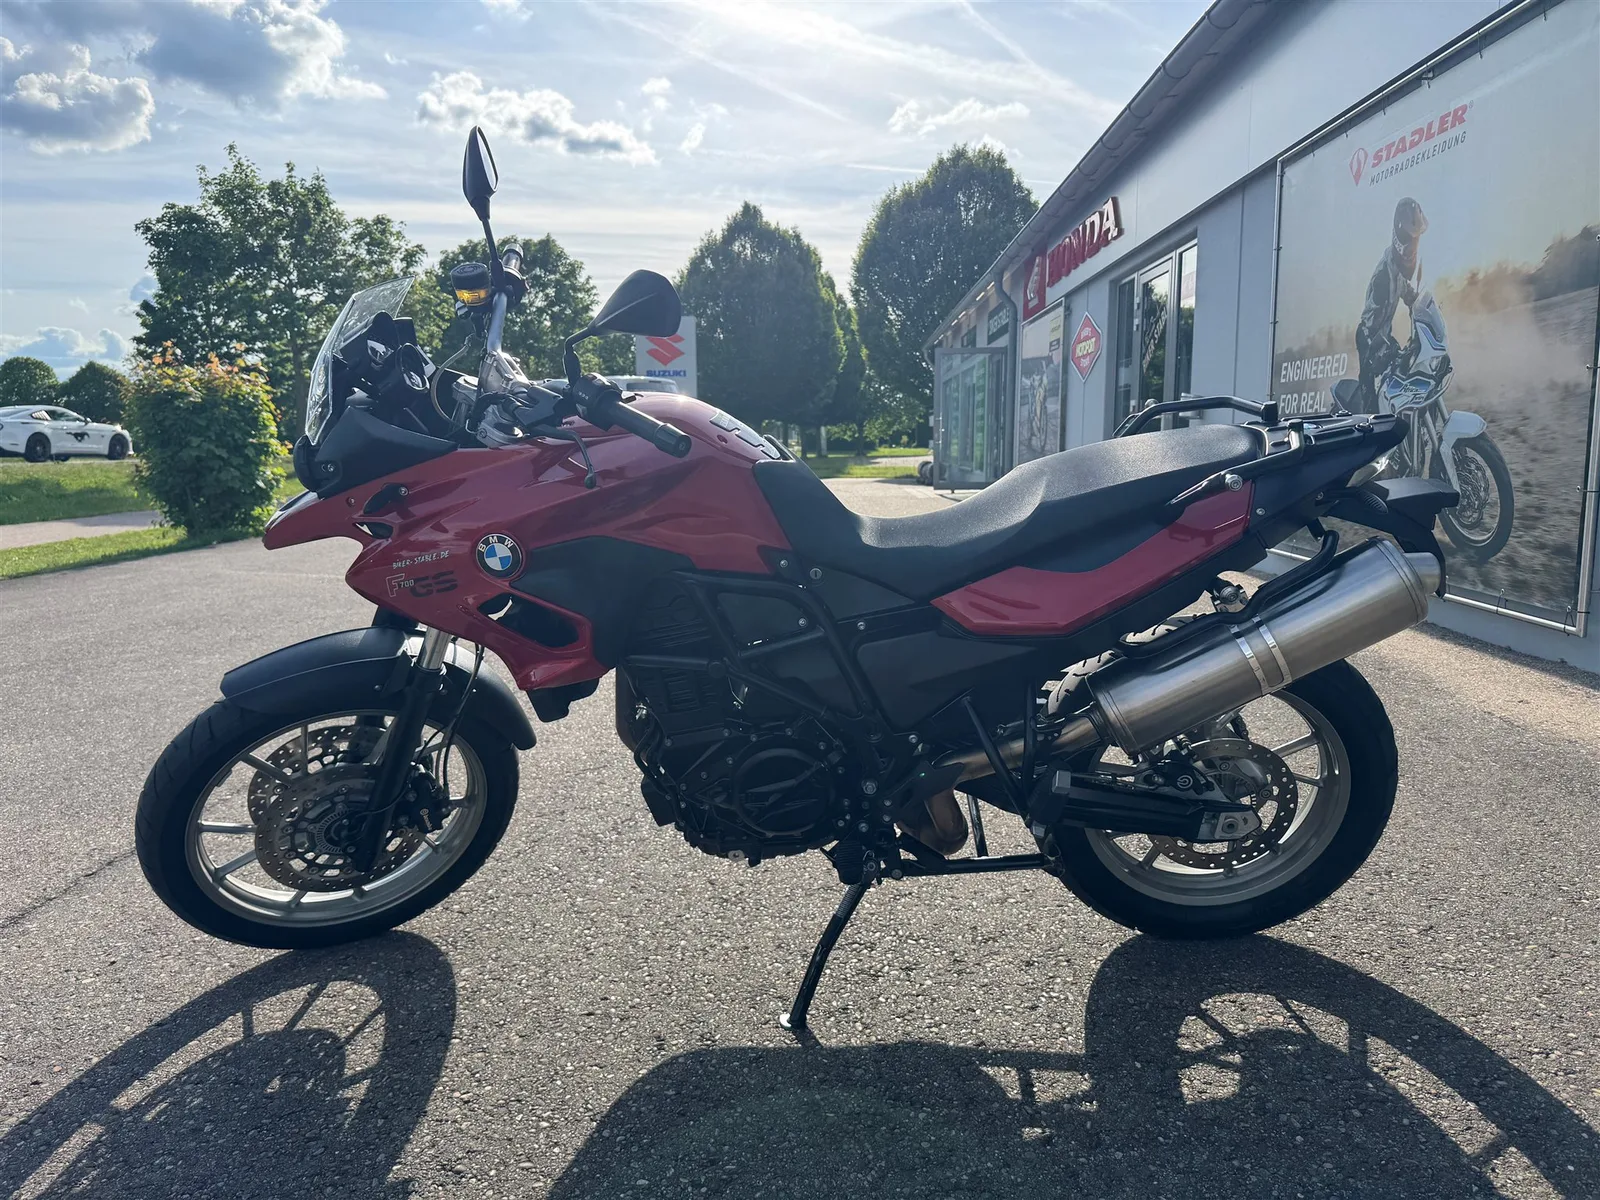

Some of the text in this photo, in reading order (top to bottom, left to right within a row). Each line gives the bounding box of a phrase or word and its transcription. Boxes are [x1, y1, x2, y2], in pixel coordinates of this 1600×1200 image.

[1371, 103, 1468, 168] STADLER
[1369, 131, 1467, 186] MOTORRADBEKLEIDUNG
[1046, 197, 1121, 286] HONDA
[646, 369, 687, 378] SUZUKI
[1280, 352, 1348, 383] ENGINEERED
[1279, 391, 1327, 415] FOR REAL
[478, 535, 514, 552] BMW
